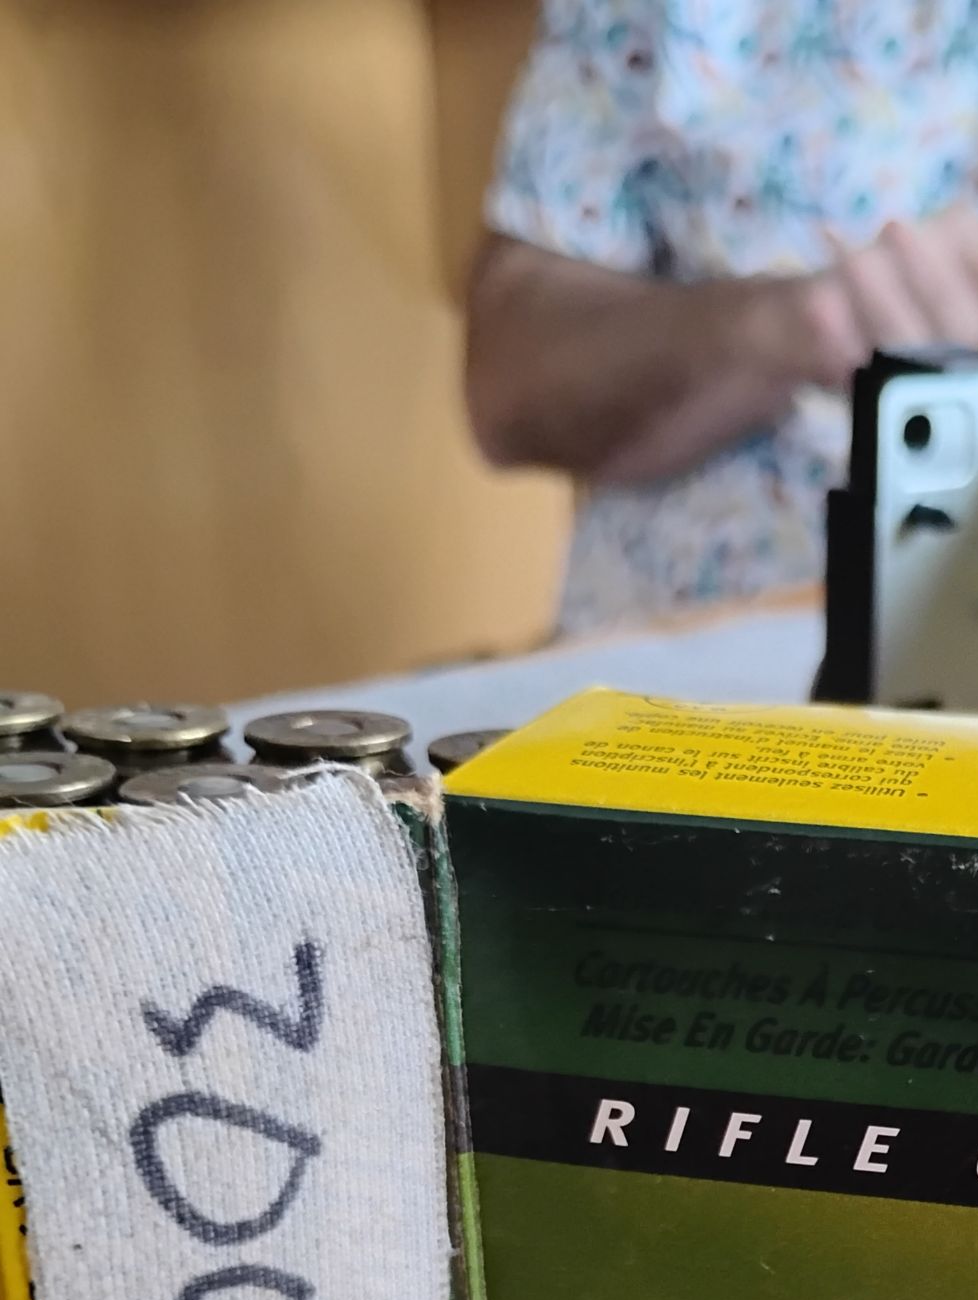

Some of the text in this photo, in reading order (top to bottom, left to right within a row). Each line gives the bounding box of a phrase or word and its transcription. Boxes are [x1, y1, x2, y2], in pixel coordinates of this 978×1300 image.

[568, 757, 906, 798] Utilisez seulement les munitions
[704, 759, 718, 771] à
[722, 757, 873, 785] correspondent
[877, 771, 913, 789] qui
[575, 950, 789, 1007] Cartouches
[580, 1003, 678, 1047] Mise
[683, 1011, 735, 1052] En
[745, 1018, 874, 1062] Garde:
[589, 1098, 901, 1175] RIFLE
